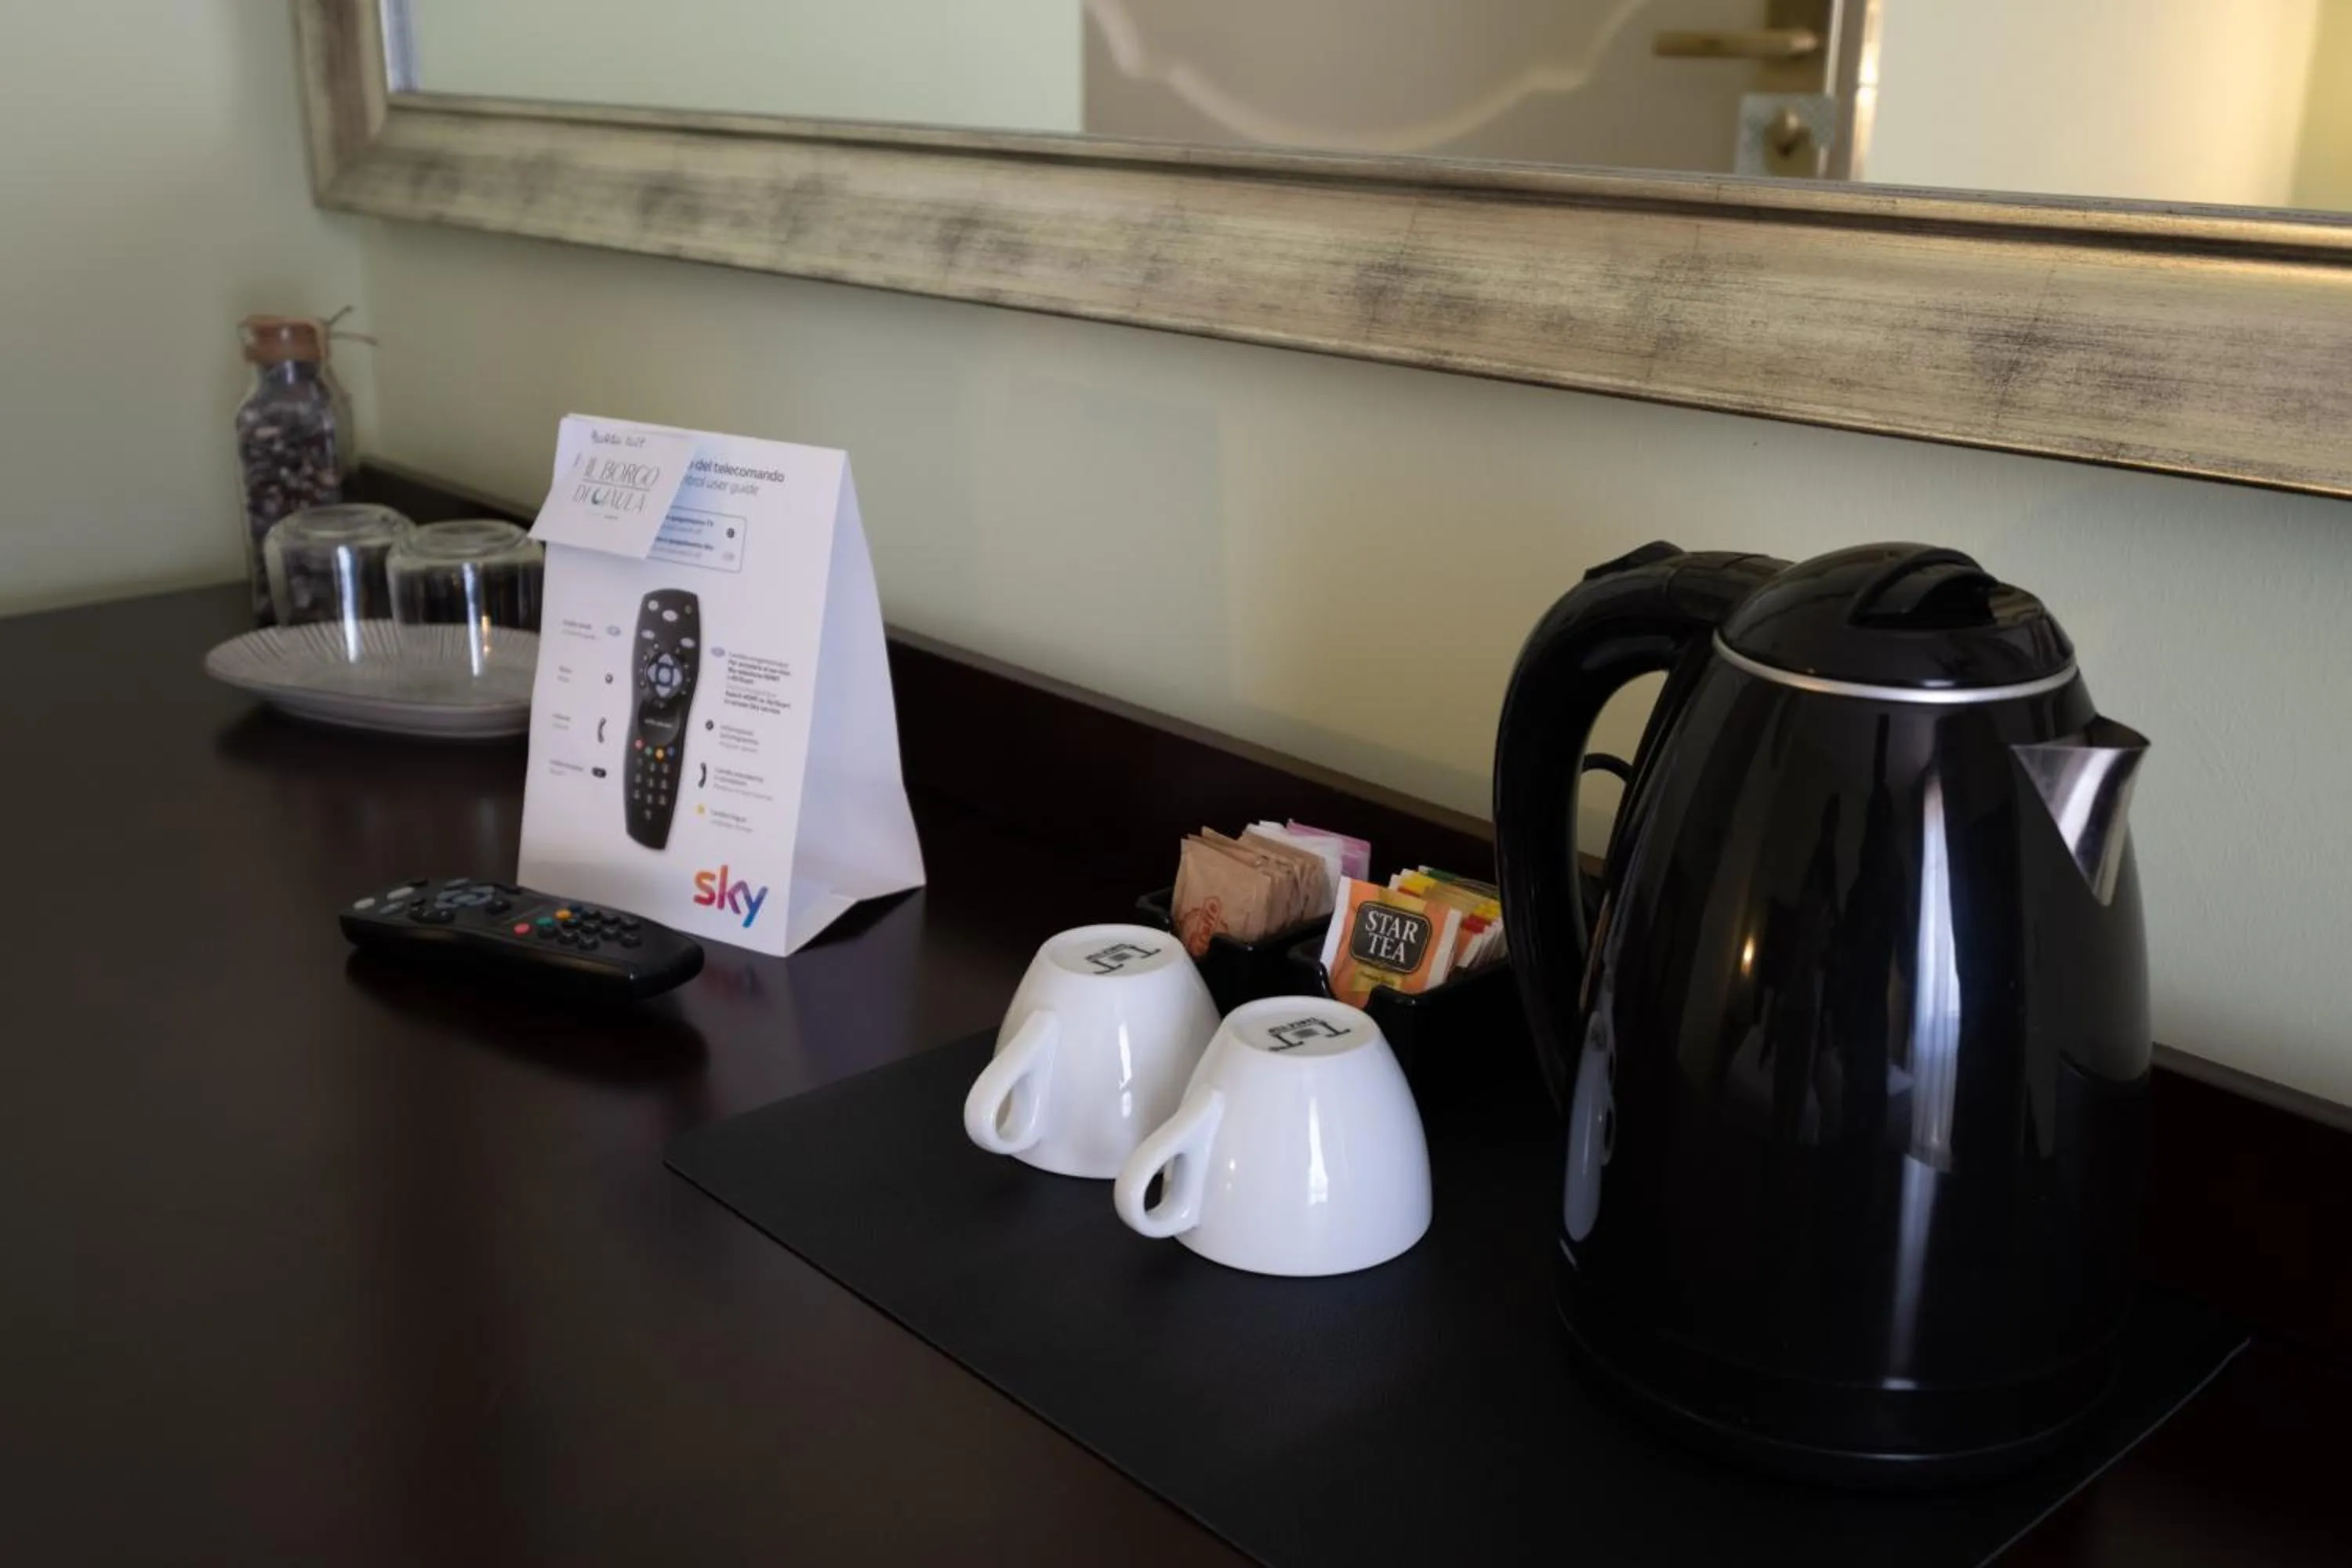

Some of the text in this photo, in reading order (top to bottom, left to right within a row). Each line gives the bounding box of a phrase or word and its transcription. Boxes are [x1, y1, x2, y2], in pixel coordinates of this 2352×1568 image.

[695, 458, 786, 483] del telecomando
[706, 479, 728, 491] user
[729, 482, 760, 495] guide
[693, 865, 768, 928] sky
[1365, 909, 1418, 944] STAR
[1367, 932, 1406, 964] TEA
